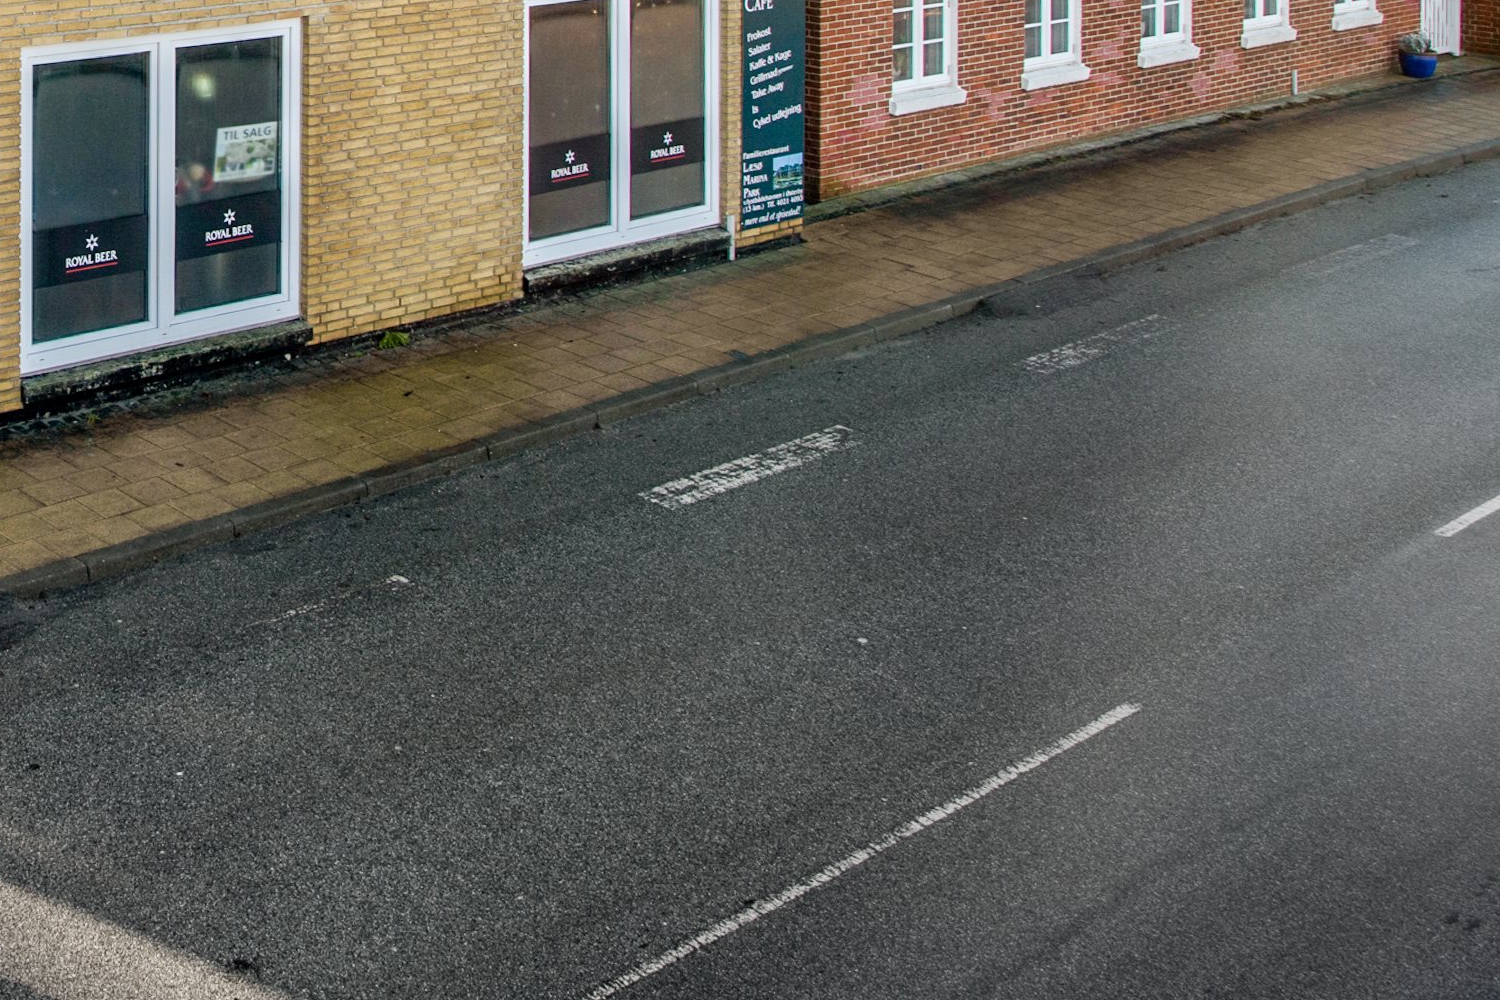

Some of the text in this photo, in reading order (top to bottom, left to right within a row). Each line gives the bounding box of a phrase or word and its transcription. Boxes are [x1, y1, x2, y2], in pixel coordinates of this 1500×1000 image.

[767, 55, 774, 64] &
[224, 126, 271, 140] TIL SALG
[651, 145, 685, 159] ROYAL BEER
[551, 163, 589, 178] ROYAL BEER
[205, 224, 254, 242] ROYAL BEER
[66, 250, 117, 268] ROYAL BEER
